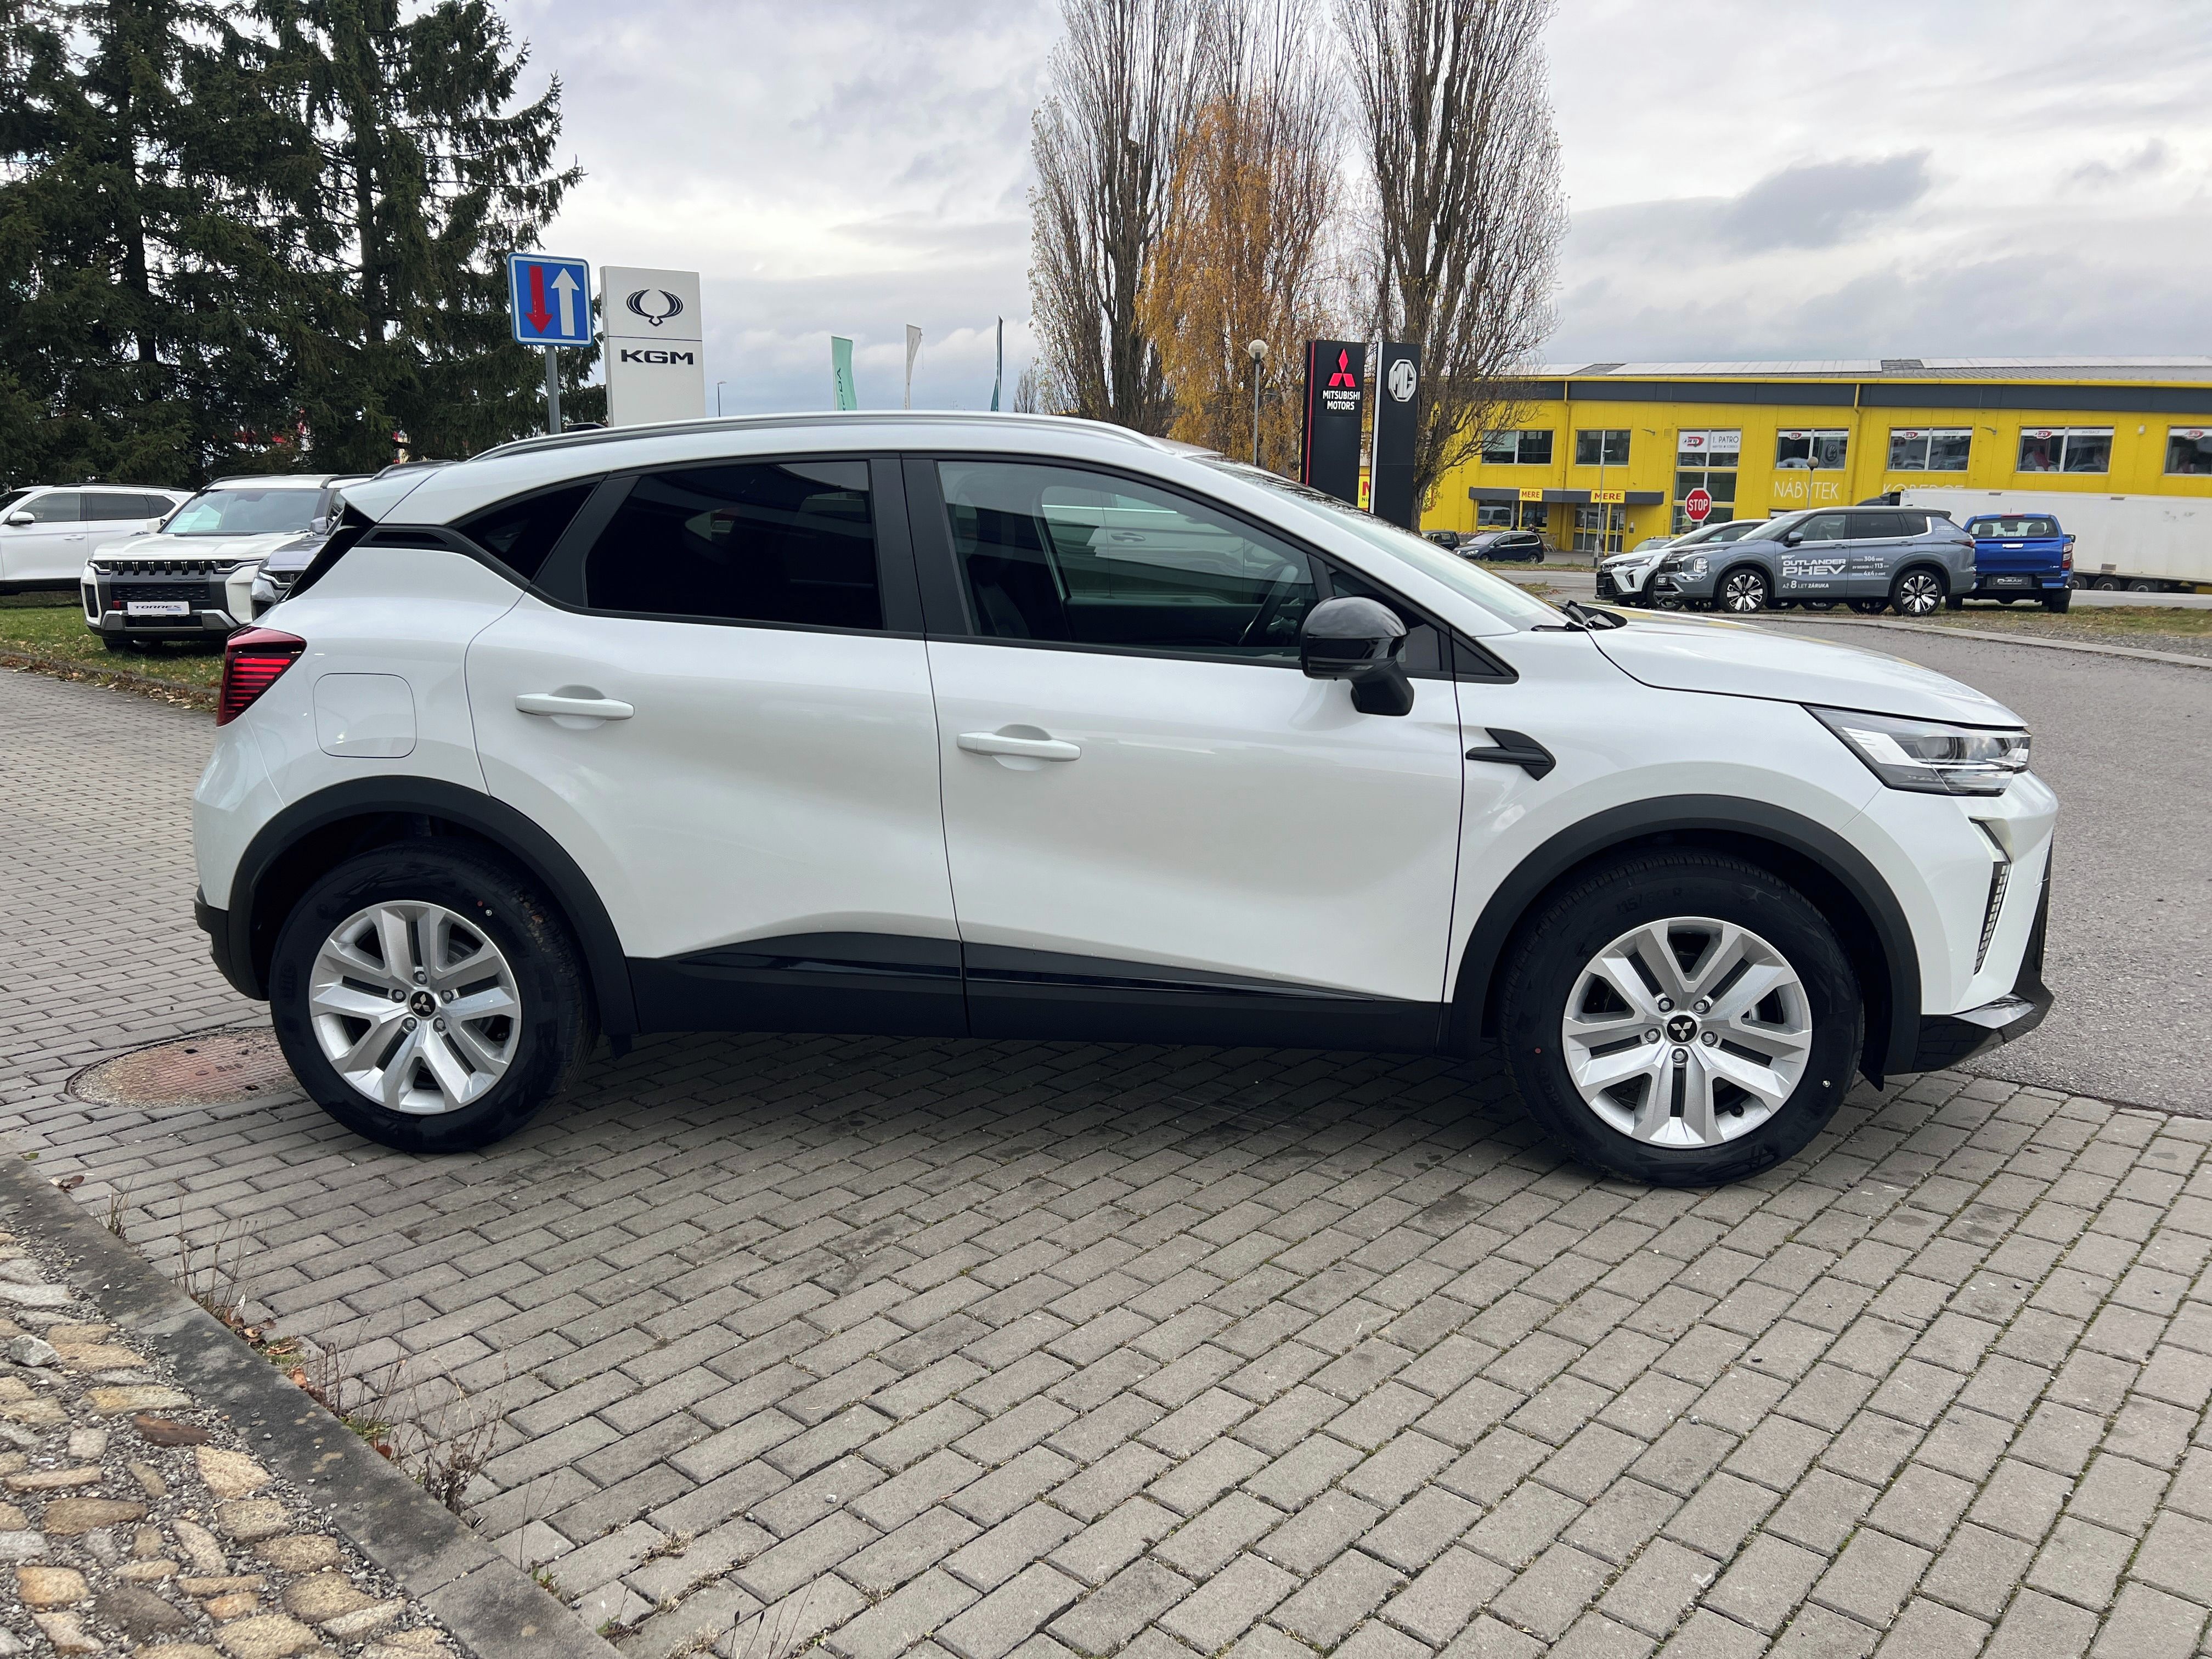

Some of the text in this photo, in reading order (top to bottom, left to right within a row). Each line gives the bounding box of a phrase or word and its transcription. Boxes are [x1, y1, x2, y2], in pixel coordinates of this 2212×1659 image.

[620, 349, 694, 365] KGM
[1323, 390, 1361, 400] MITSUBISHI
[1327, 400, 1355, 410] MOTORS
[1774, 477, 1839, 500] NÁBYTEK
[1688, 498, 1708, 511] STOP
[1782, 565, 1846, 576] PHEV
[1790, 580, 1797, 589] 8
